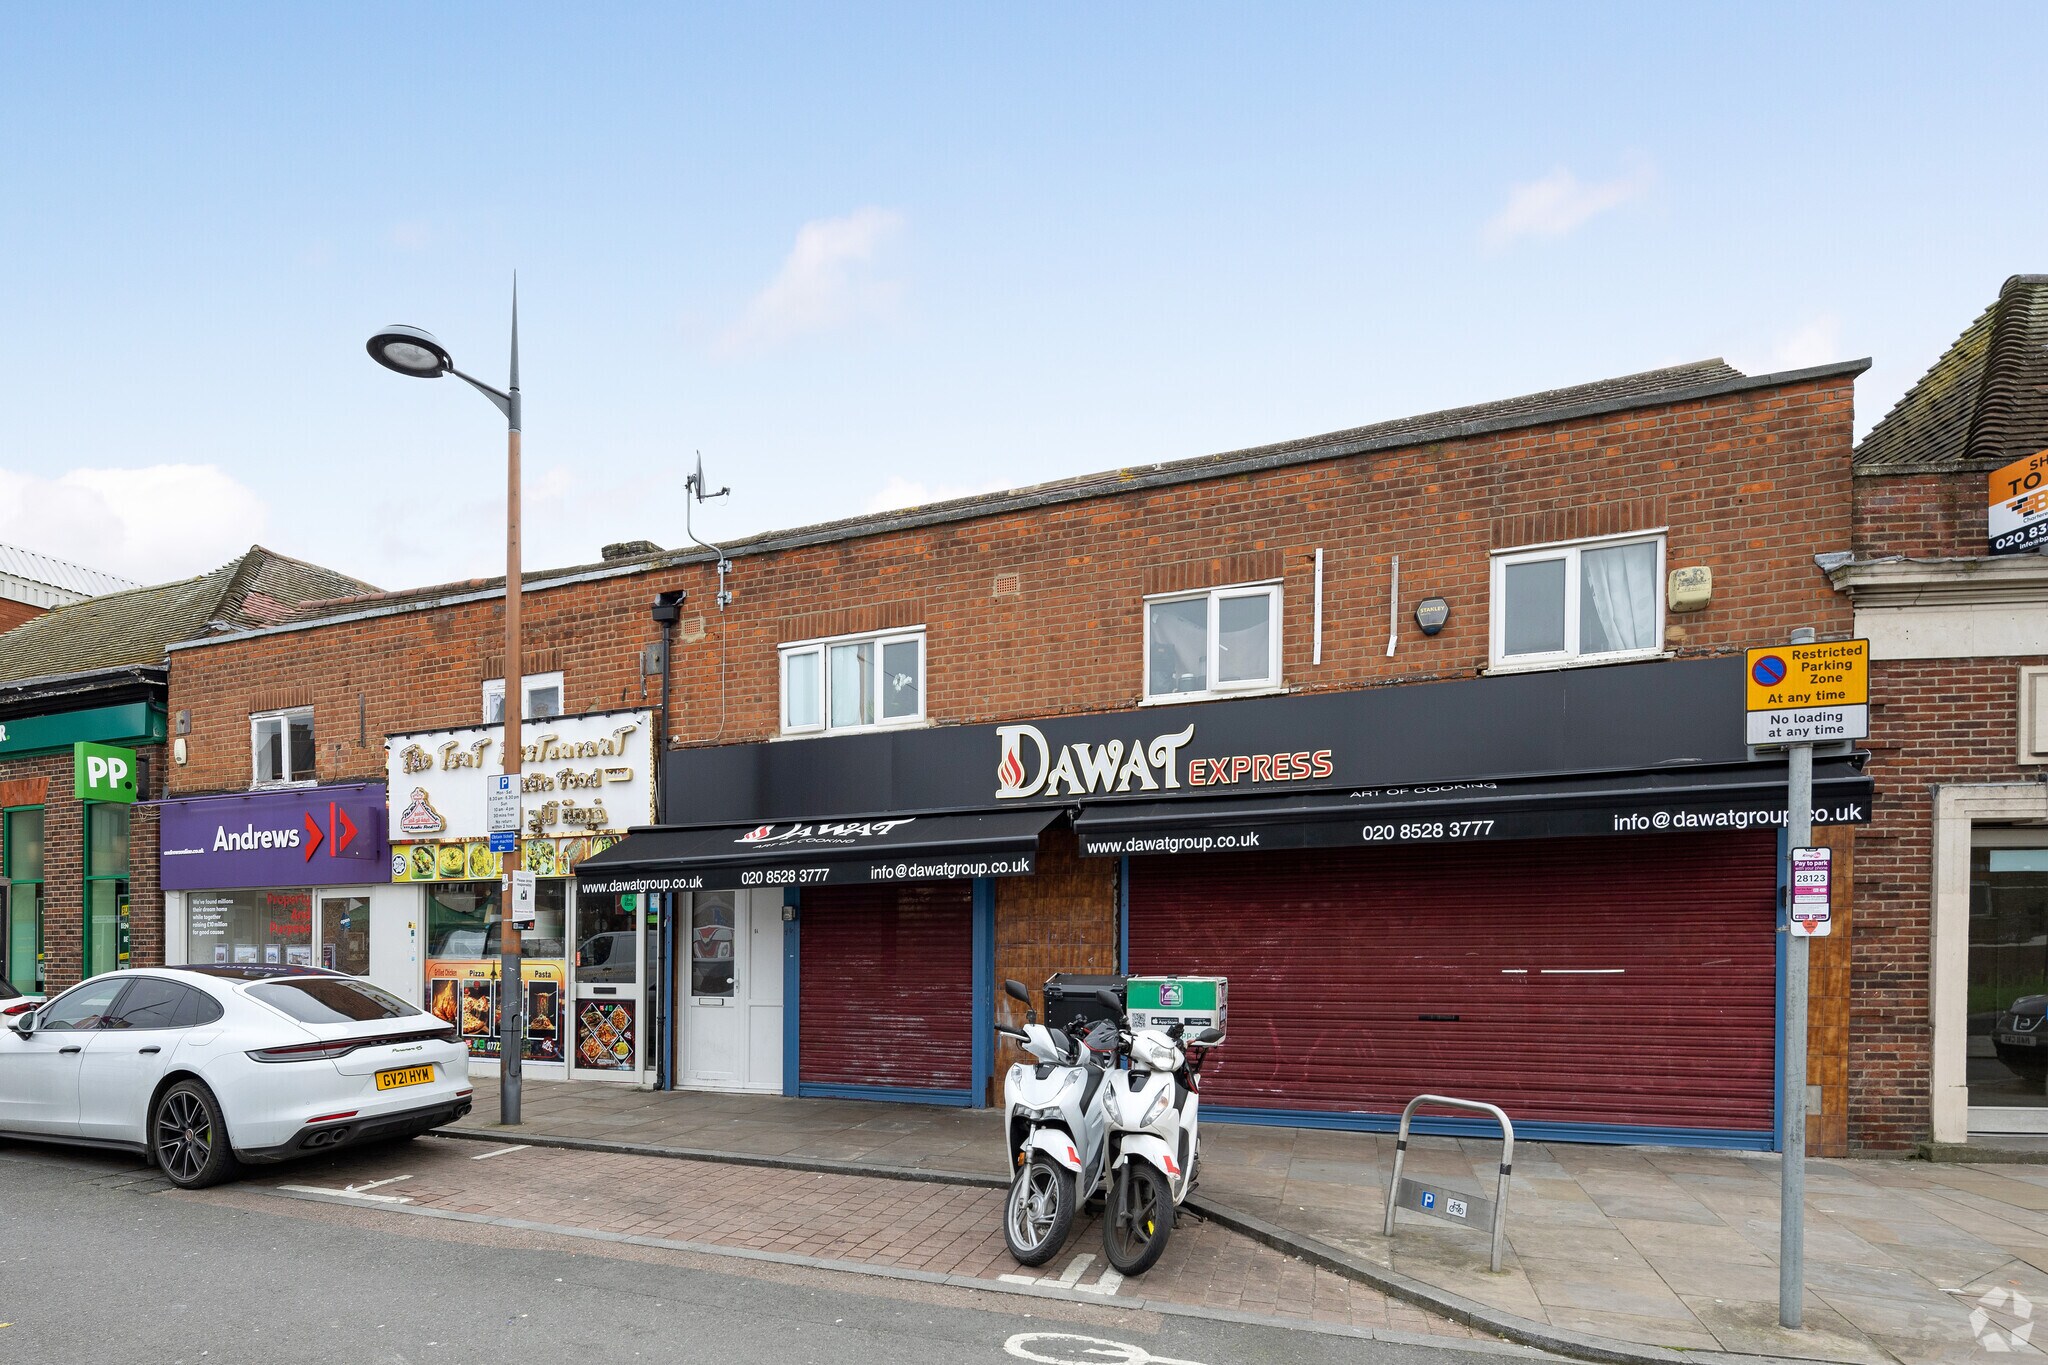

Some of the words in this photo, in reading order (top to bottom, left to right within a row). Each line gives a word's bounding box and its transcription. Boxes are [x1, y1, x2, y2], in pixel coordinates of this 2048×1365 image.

[2008, 472, 2042, 496] TO
[1995, 532, 2025, 550] 020
[2028, 522, 2048, 539] 83
[1420, 605, 1446, 614] STANLEY
[1792, 645, 1863, 661] Restricted
[1801, 659, 1853, 674] Parking
[1810, 674, 1843, 685] Zone
[1768, 694, 1783, 705] At
[1787, 692, 1811, 704] any
[1816, 689, 1846, 701] time
[1770, 715, 1789, 725] No
[1793, 711, 1843, 725] loading
[1768, 727, 1781, 738] at
[1786, 726, 1810, 738] any
[1815, 723, 1844, 735] time
[1189, 749, 1333, 787] EXPRESS
[501, 778, 508, 789] P
[1349, 790, 1382, 798] ART
[1414, 782, 1499, 795] COOKING
[212, 824, 300, 852] Andrews
[1362, 825, 1395, 842] 020
[1399, 822, 1444, 840] 8528
[1448, 820, 1495, 837] 3777
[1086, 831, 1260, 855] www.dawatgroup.co.uk
[870, 857, 1030, 880] info@dawatgroup.co.uk
[1814, 859, 1828, 867] park
[741, 871, 765, 885] 020
[766, 869, 796, 884] 8528
[799, 867, 830, 882] 3777
[1796, 874, 1826, 883] 28123
[582, 874, 703, 894] www.dawatgroup.co.uk
[266, 893, 311, 908] Property
[291, 908, 311, 921] And
[269, 922, 311, 938] Purpose
[445, 968, 458, 977] Chicken
[469, 969, 485, 977] Pizza
[534, 969, 552, 978] Pasta
[383, 1071, 408, 1087] GV21
[409, 1068, 430, 1083] HYM
[1424, 1193, 1434, 1207] P
